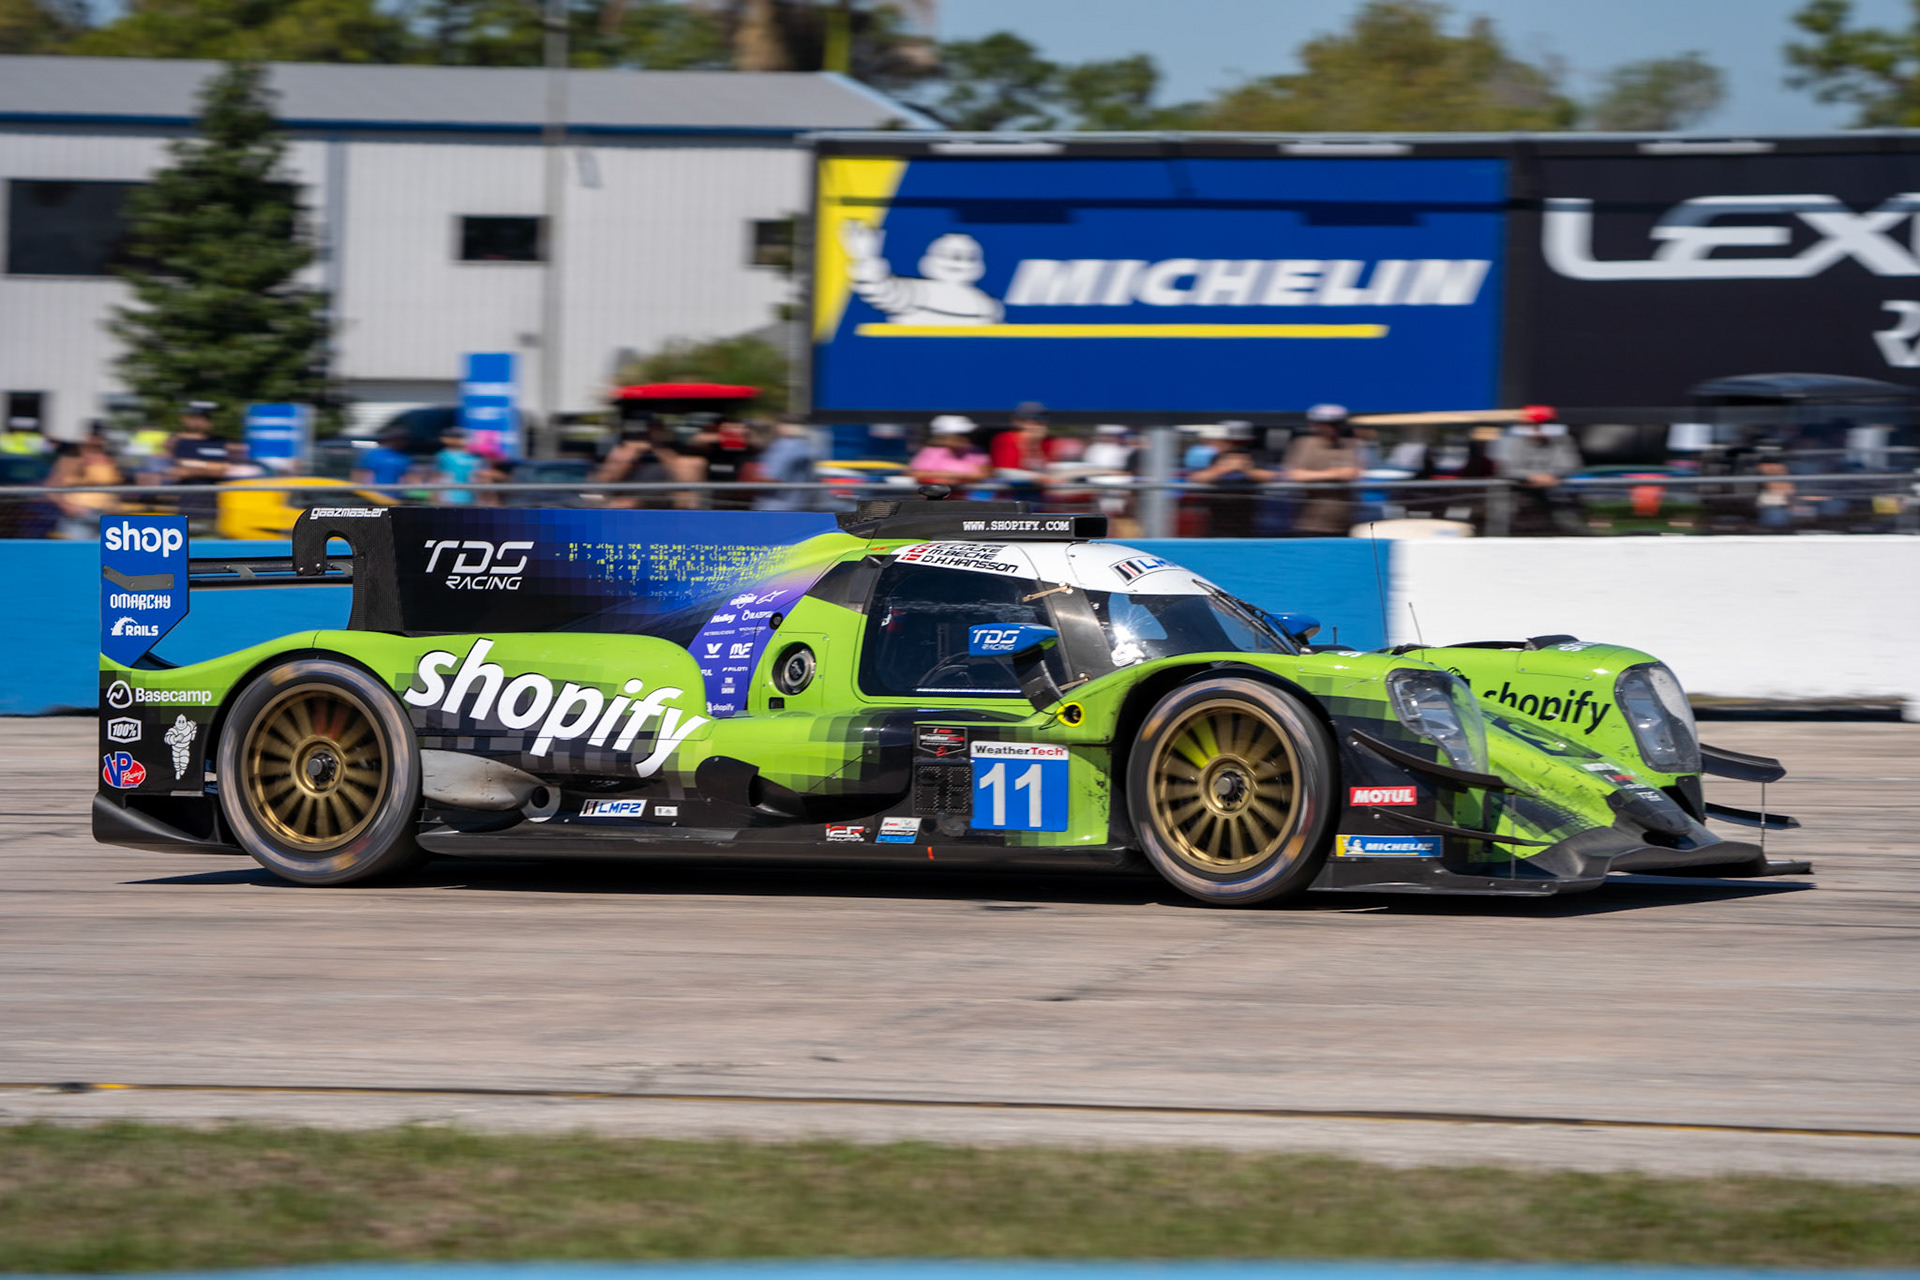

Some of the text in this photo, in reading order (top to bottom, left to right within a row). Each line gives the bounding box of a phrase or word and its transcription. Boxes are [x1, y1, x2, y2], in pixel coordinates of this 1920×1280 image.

[1541, 194, 1920, 280] LEX
[1005, 259, 1492, 306] MICHELIN
[962, 520, 1070, 531] WWW.SHOPIFY.COM
[105, 520, 183, 558] shop
[424, 539, 535, 574] TDS
[927, 548, 998, 560] M.BECHE
[921, 554, 1019, 573] D.H.HANSSON
[445, 575, 523, 590] RACING
[110, 593, 171, 610] OMARCHY
[125, 625, 159, 637] RAILS
[973, 629, 1020, 643] TDS
[981, 643, 1016, 651] RACING
[135, 688, 212, 705] Basecamp
[403, 636, 710, 778] shopify
[713, 703, 735, 712] shopify
[112, 723, 137, 737] 100%
[975, 745, 1066, 757] WeatherTech
[103, 752, 134, 787] VP
[122, 771, 146, 783] Racing
[978, 763, 1043, 828] 11
[1353, 789, 1414, 803] MOTUL
[598, 803, 641, 813] LMP2
[1364, 843, 1434, 851] MICHELIN
